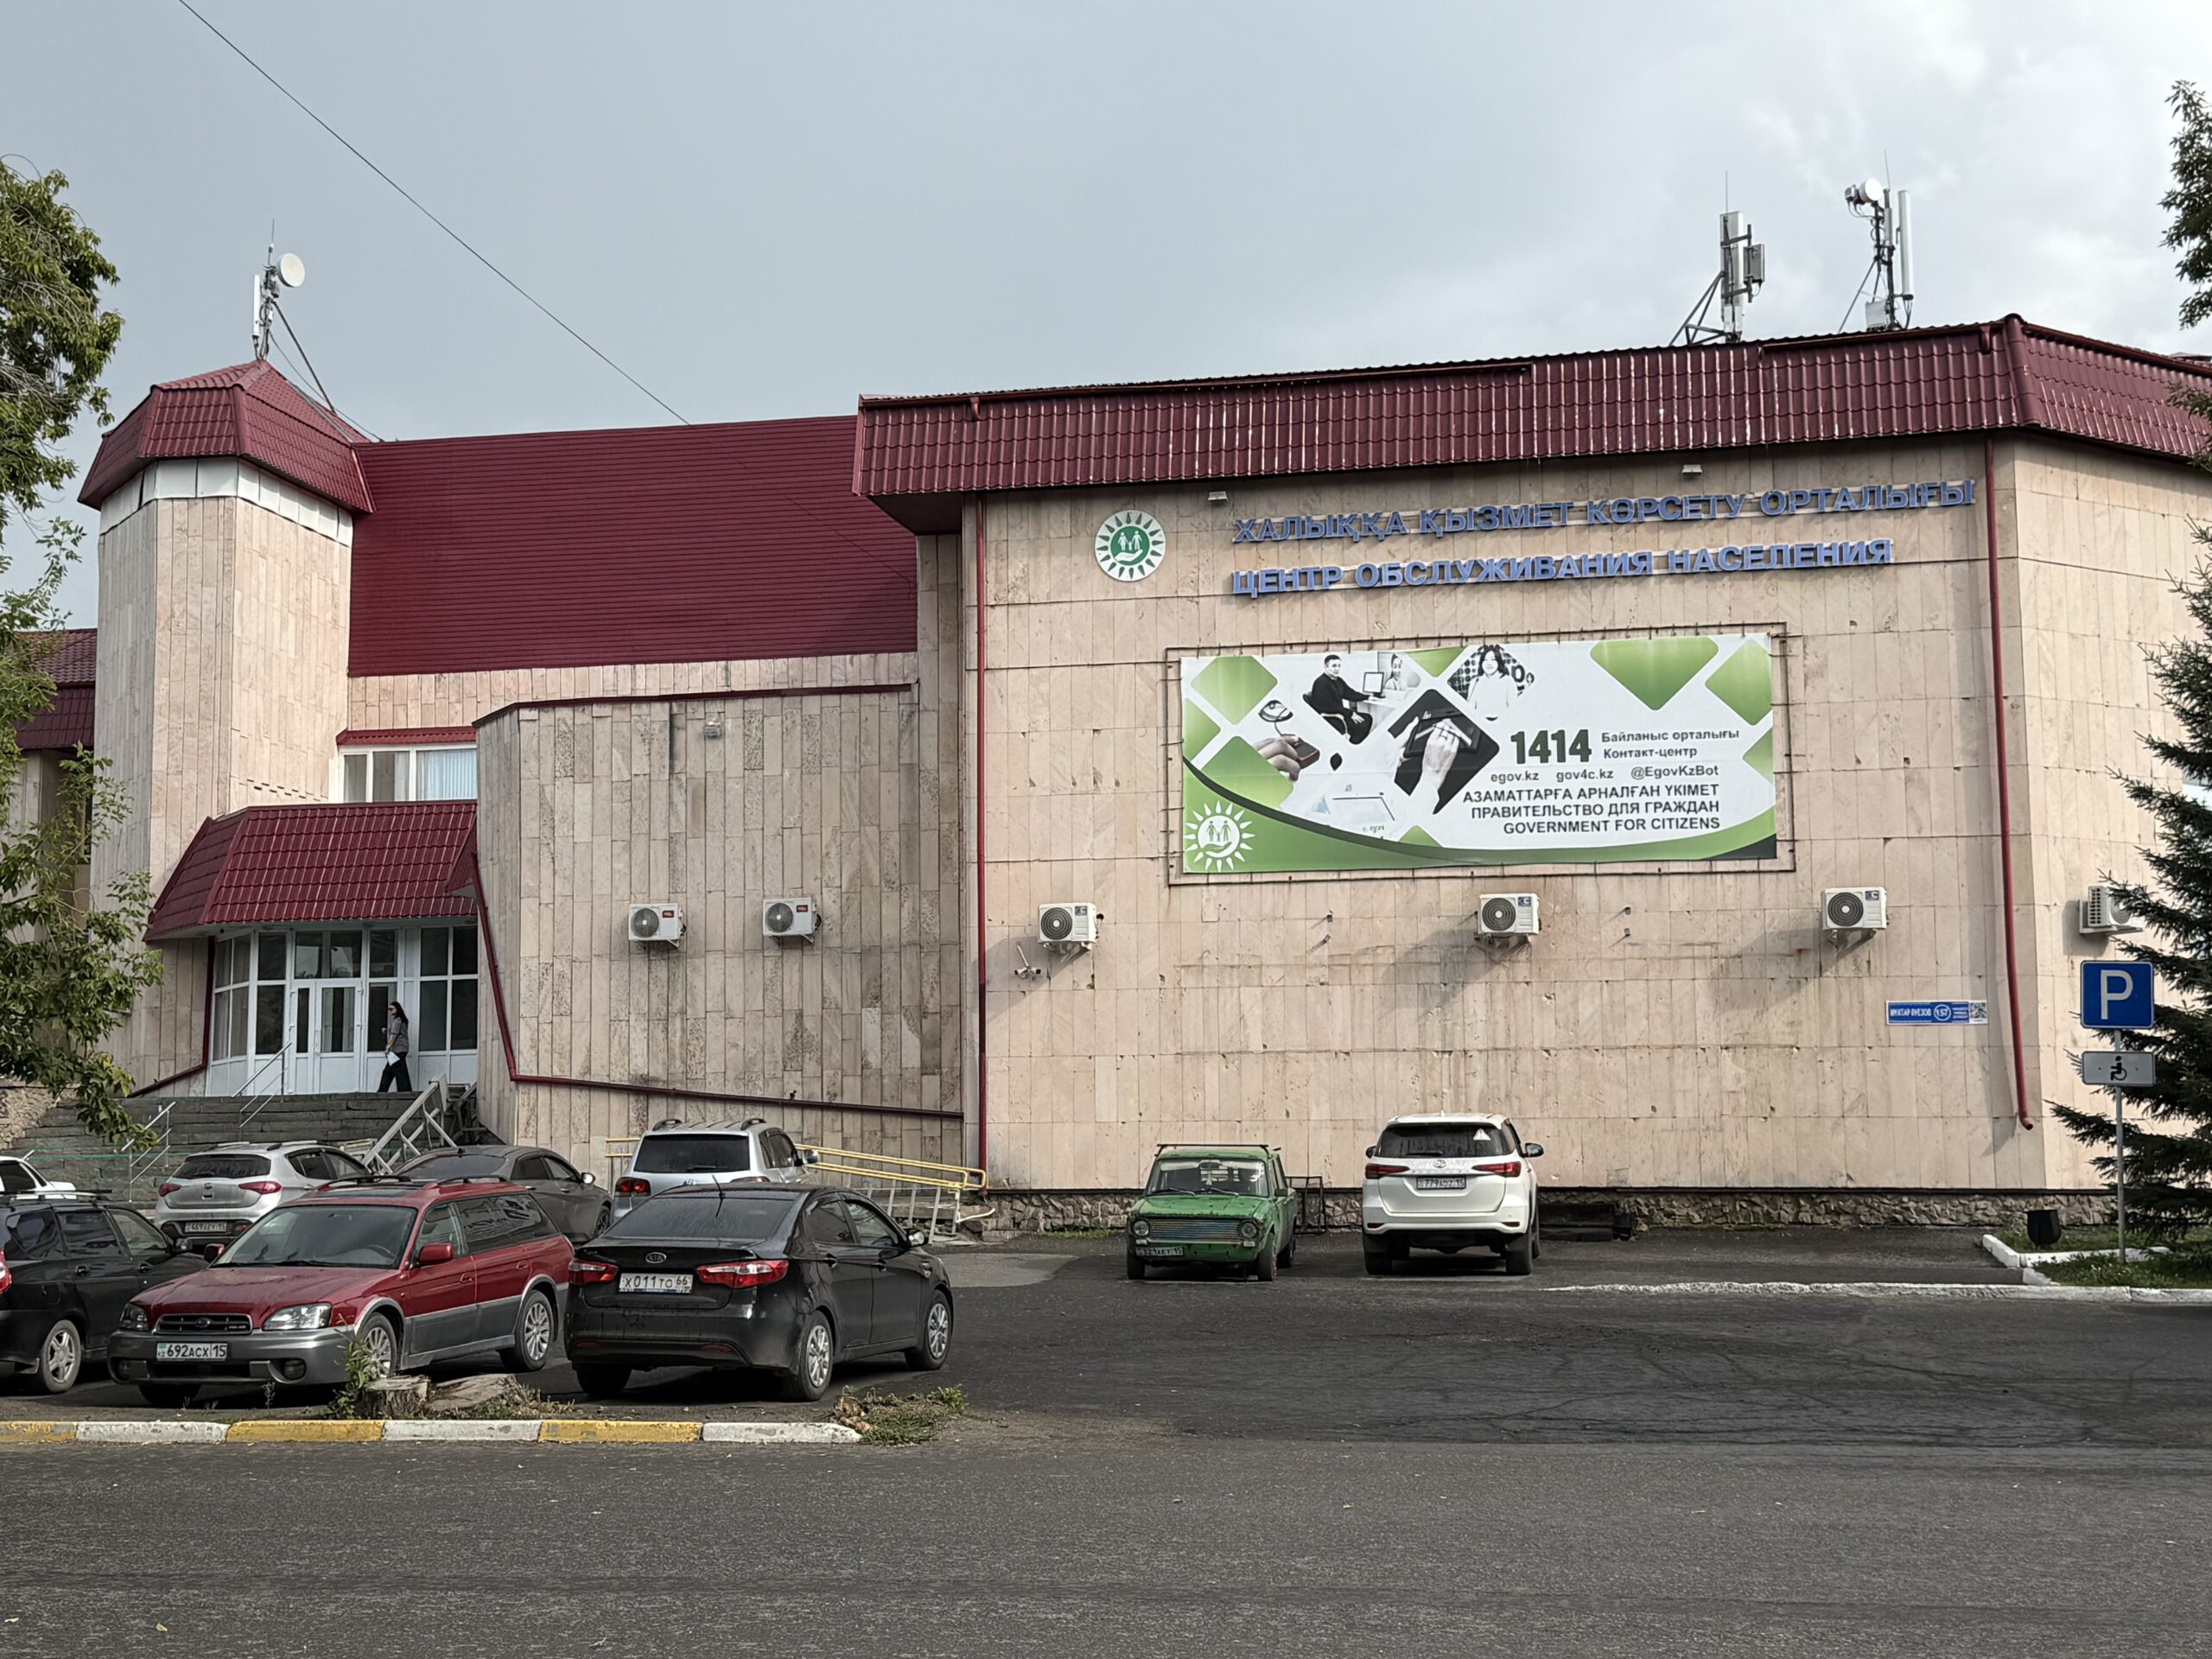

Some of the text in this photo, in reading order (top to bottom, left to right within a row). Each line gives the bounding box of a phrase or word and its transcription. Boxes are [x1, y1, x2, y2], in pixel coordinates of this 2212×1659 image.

[1233, 480, 1973, 542] ХАЛЫҚҚА ҚЫЗМЕТ КӨРСЕТУ ОРТАЛЫҒЫ
[1232, 538, 1892, 598] ЦЕНТР ОБСЛУЖИВАНИЯ НАСЕЛЕНИЯ
[1601, 730, 1739, 743] Байланыс орталығы
[1510, 729, 1592, 765] 1414
[1604, 747, 1697, 759] Контакт-центр
[1491, 766, 1719, 785] egov.kz gov4c.kz @EgovKzBot
[1463, 788, 1573, 803] АЗАМАТТАРҒА
[1577, 785, 1660, 800] АРНАЛҒАН
[1471, 801, 1719, 818] ПРАВИТЕЛЬСТВО ДЛЯ ГРАЖДАН
[1503, 817, 1720, 834] GOVERNMENT FOR CITIZENS
[2101, 969, 2134, 1020] P
[676, 1275, 689, 1286] 66
[167, 1344, 209, 1357] 692ACX
[213, 1344, 227, 1357] 15
